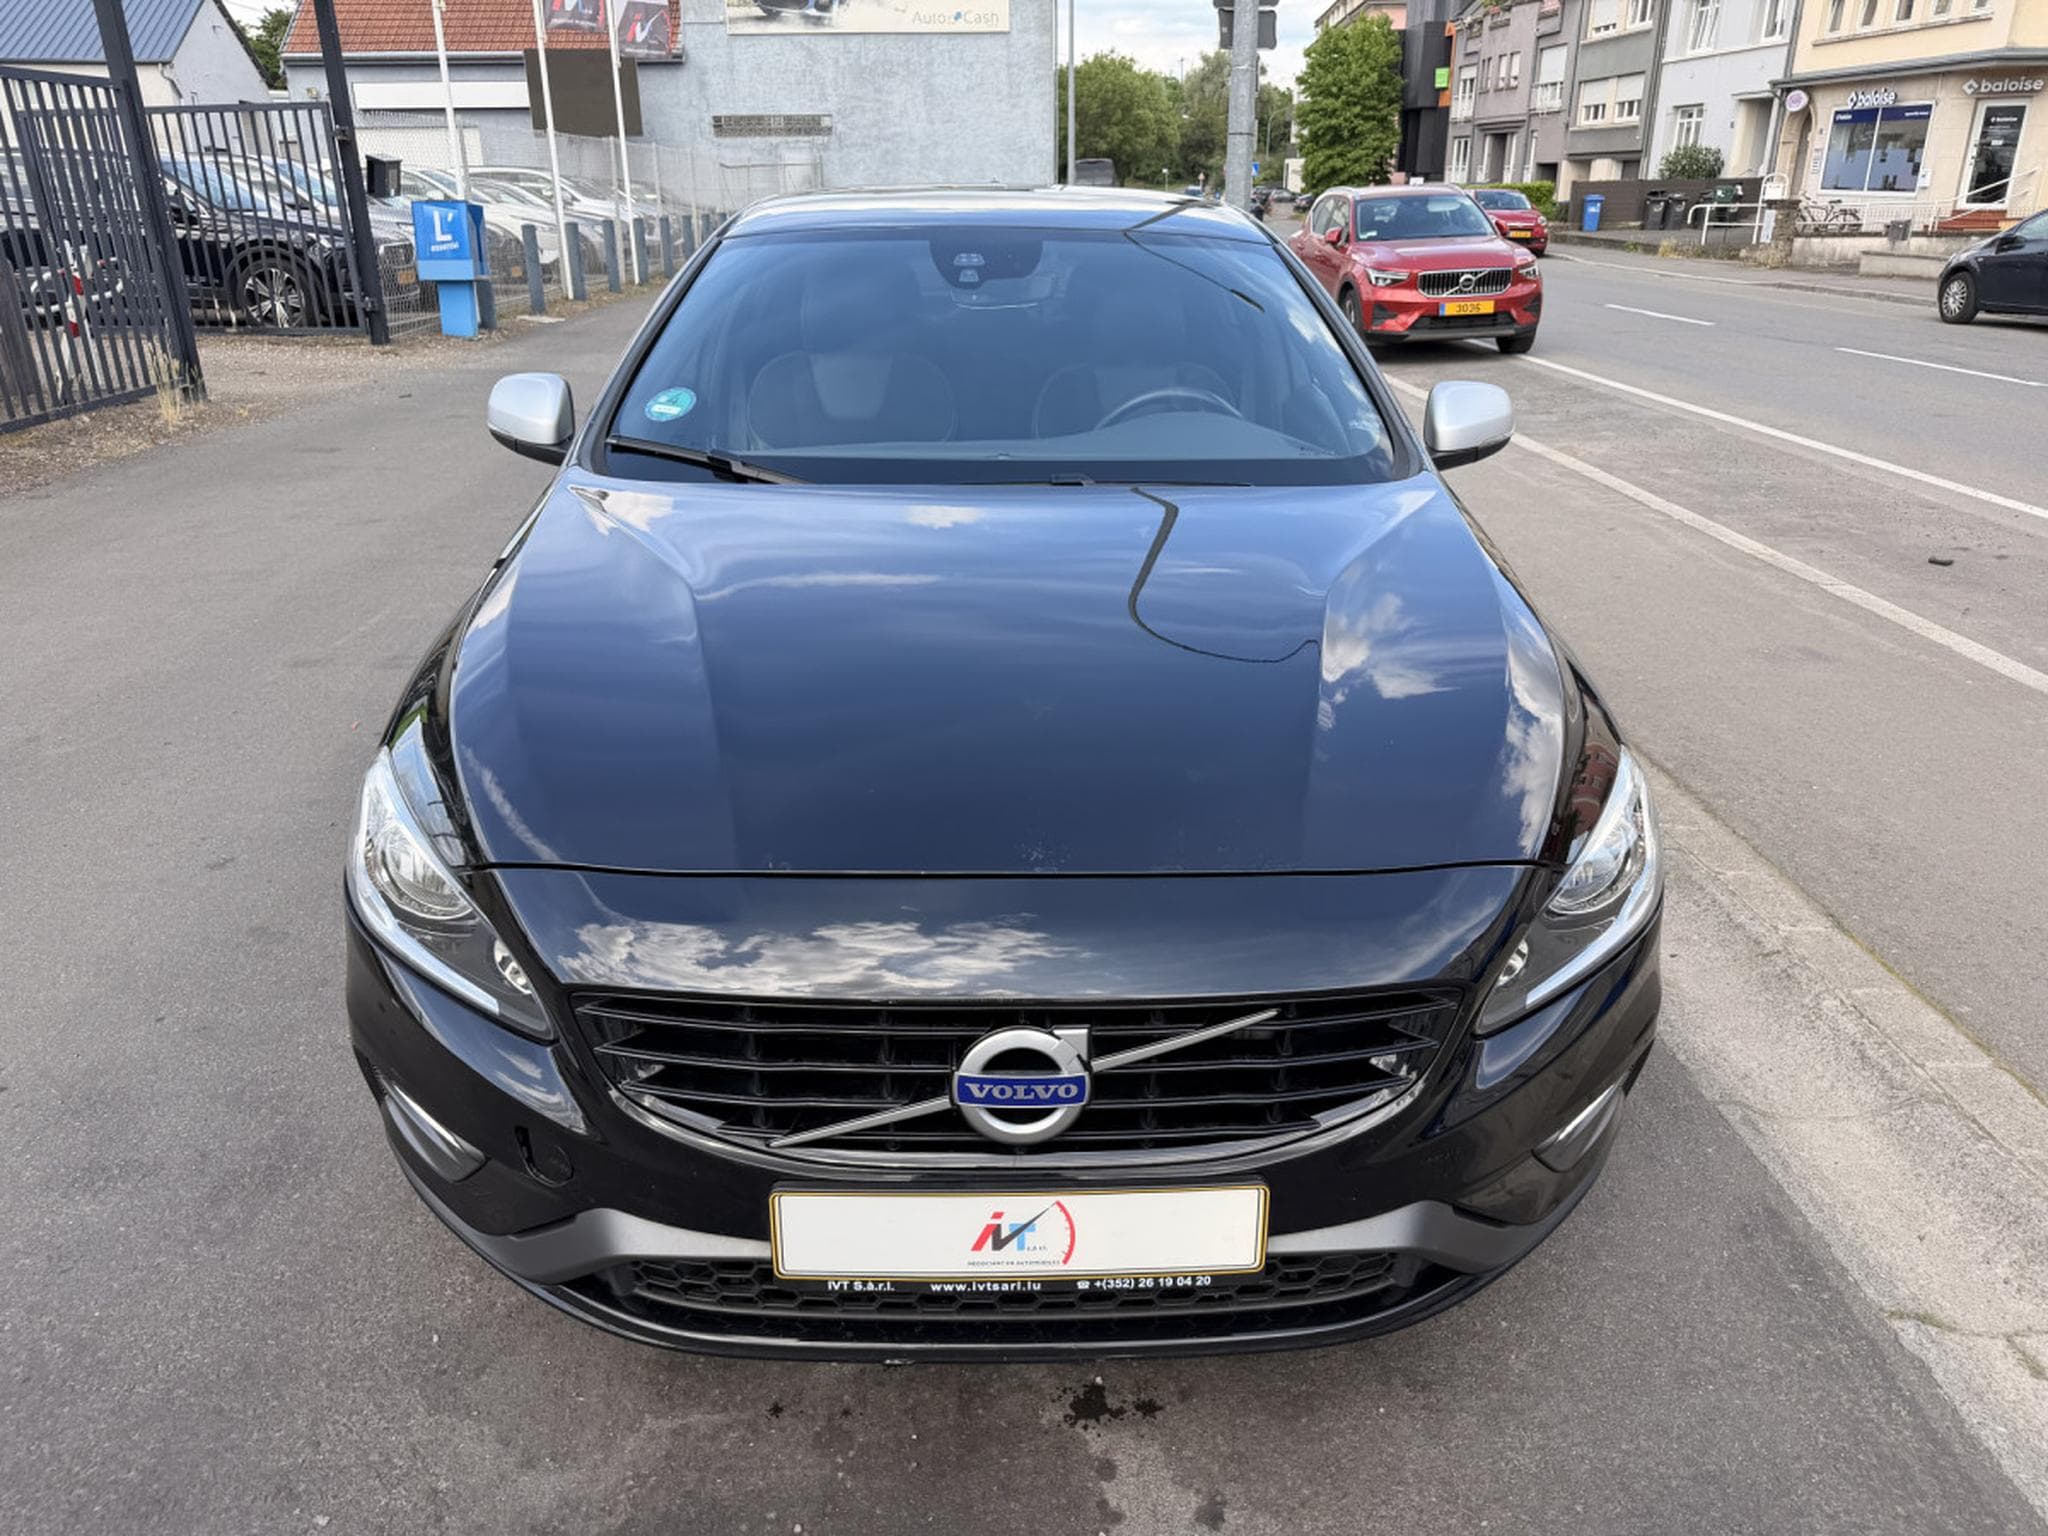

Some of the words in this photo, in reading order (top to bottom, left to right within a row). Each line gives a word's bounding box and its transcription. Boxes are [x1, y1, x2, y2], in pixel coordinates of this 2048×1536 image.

[912, 10, 945, 24] Auto
[1981, 76, 2045, 92] baloise
[1858, 88, 1897, 106] baloise
[964, 1083, 1079, 1100] VOLVO
[827, 1281, 850, 1291] IVT
[1094, 1278, 1134, 1290] +(352)
[1138, 1278, 1154, 1288] 26
[1159, 1277, 1173, 1287] 19
[1177, 1276, 1192, 1287] 04
[1196, 1275, 1212, 1286] 20
